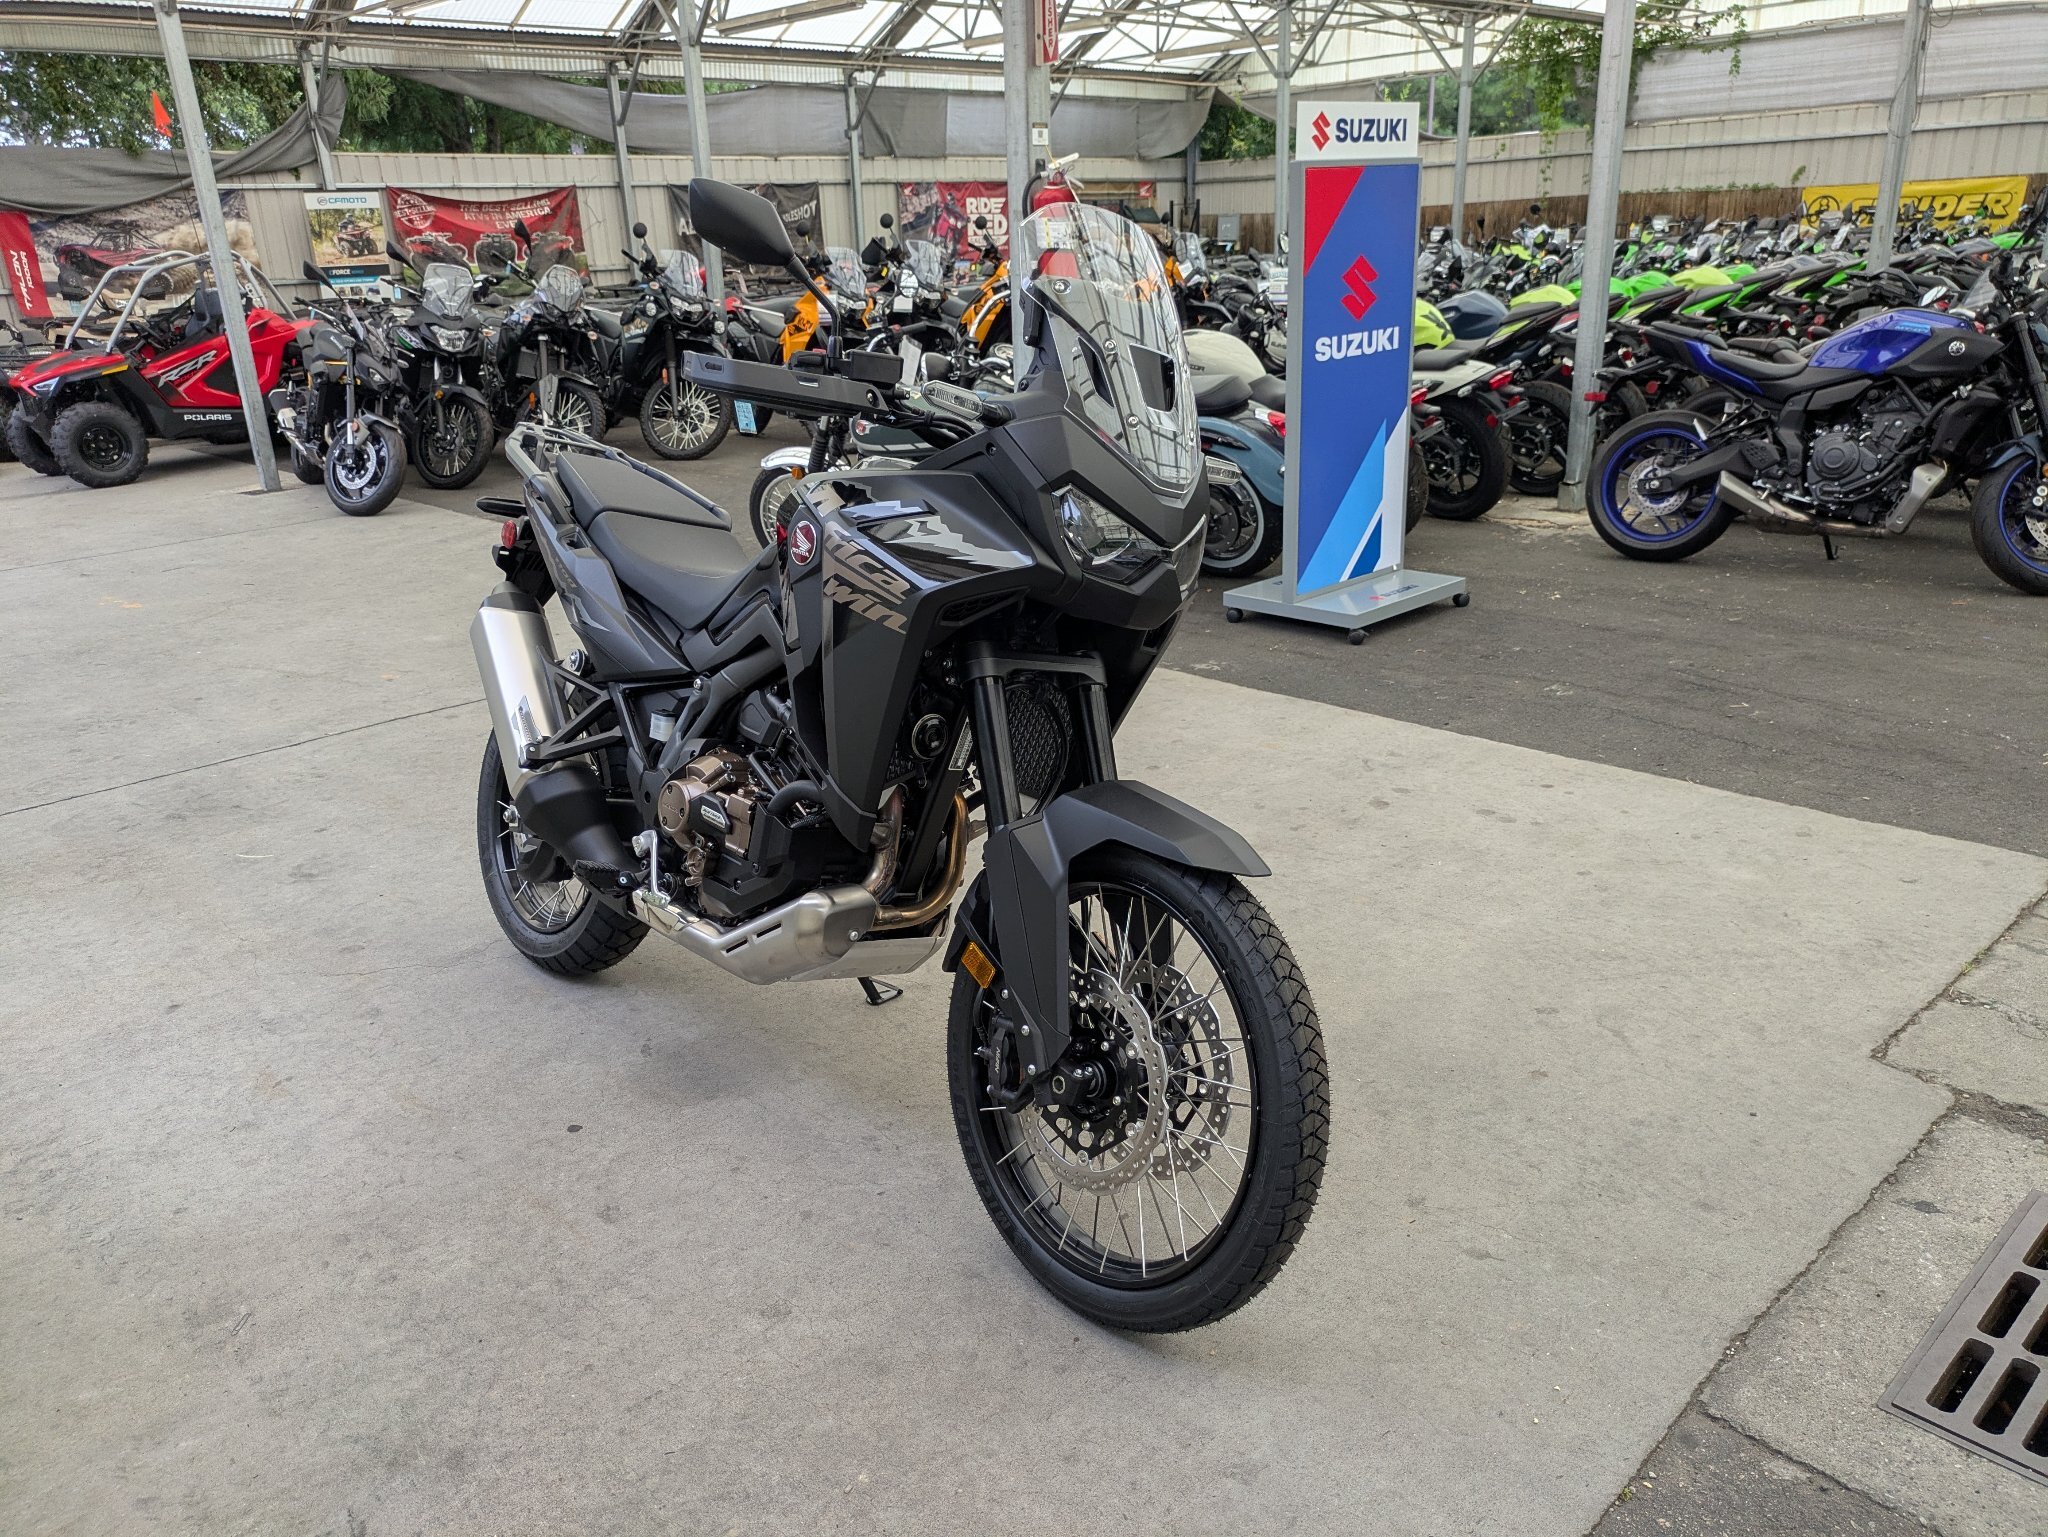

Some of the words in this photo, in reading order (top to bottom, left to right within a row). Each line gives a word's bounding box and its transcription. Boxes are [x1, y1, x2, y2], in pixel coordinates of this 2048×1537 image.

[1335, 118, 1407, 143] SUZUKI
[460, 204, 480, 212] THE
[491, 212, 503, 220] IN
[782, 200, 817, 222] OLESHOT
[965, 197, 1007, 214] RIDE
[1850, 191, 2014, 223] SRIDER
[496, 220, 517, 230] EVE
[966, 214, 1008, 236] RED
[10, 250, 33, 310] TALON
[20, 251, 34, 288] 1000R
[1314, 326, 1400, 363] SUZUKI
[158, 350, 218, 388] RZR
[791, 546, 810, 558] HONDA
